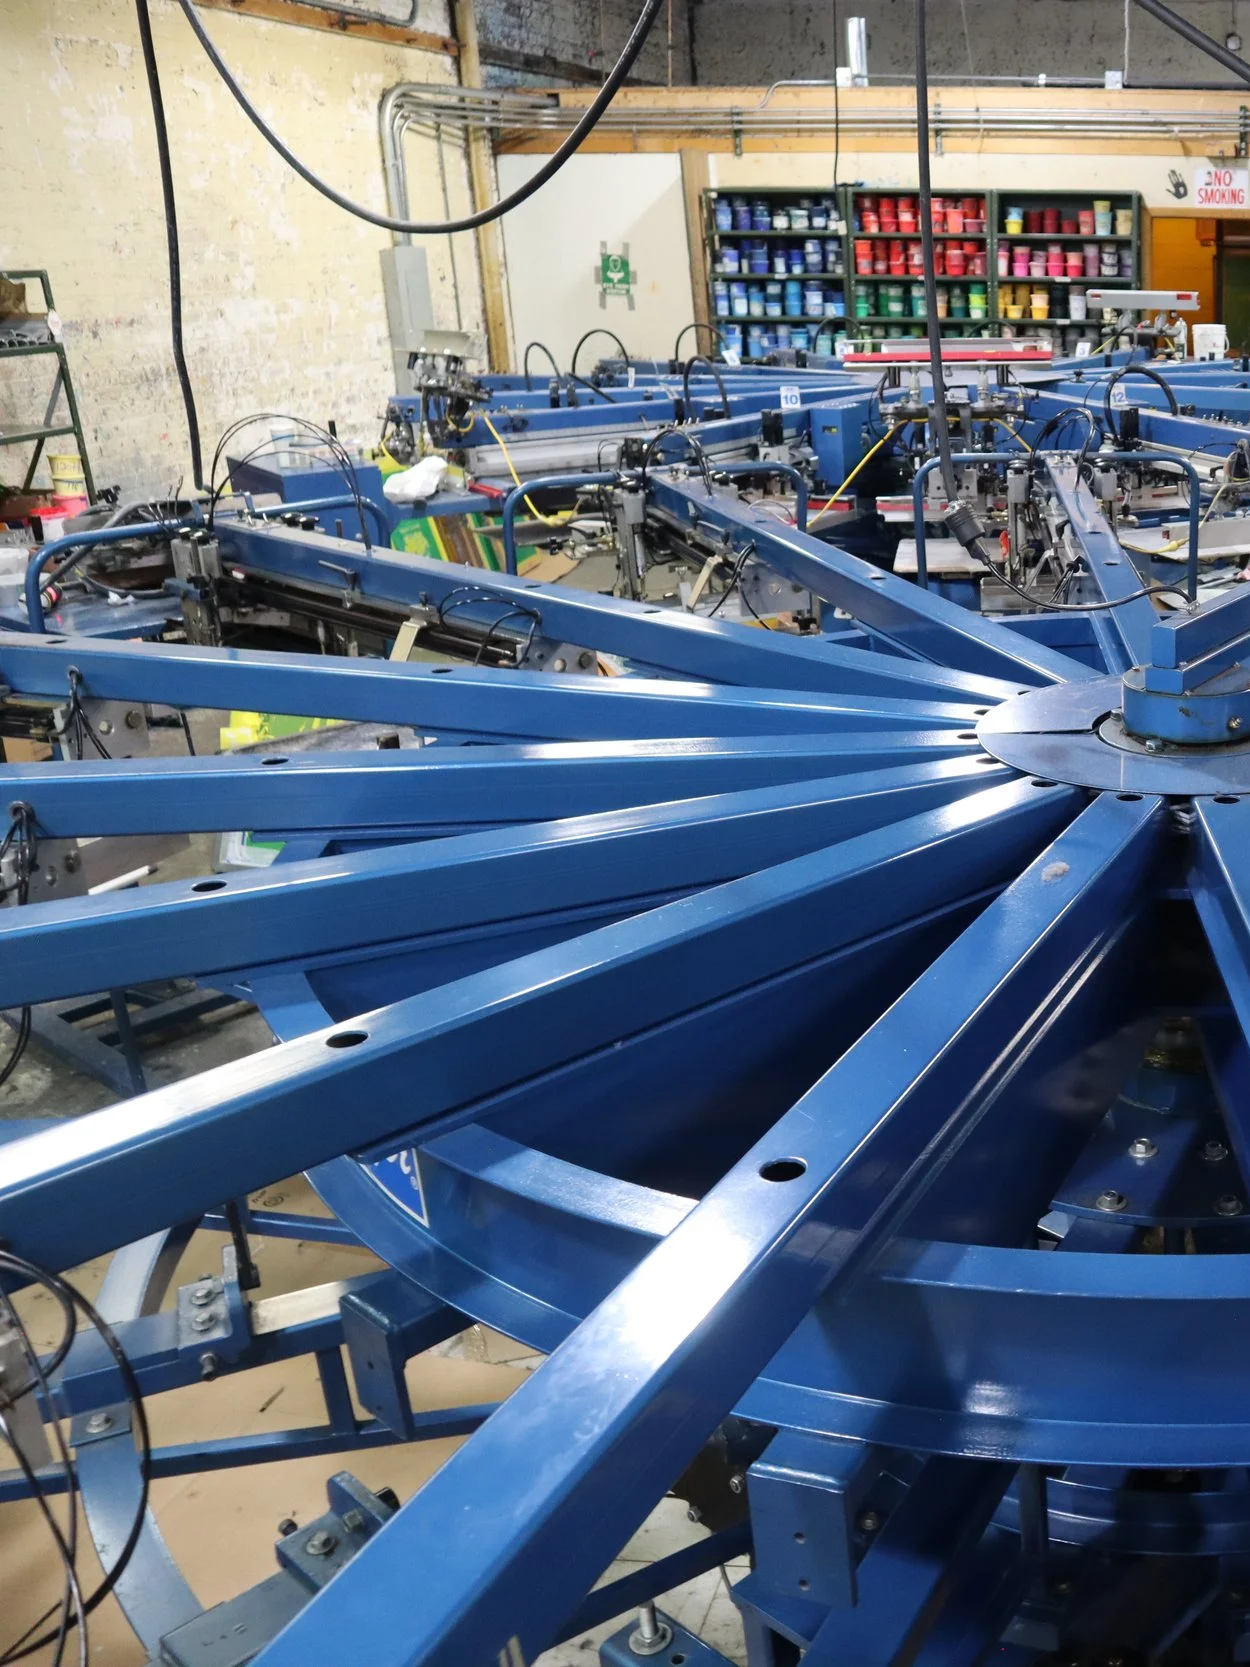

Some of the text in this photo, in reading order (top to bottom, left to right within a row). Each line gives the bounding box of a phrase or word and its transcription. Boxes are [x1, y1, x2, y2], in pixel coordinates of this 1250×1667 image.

[1213, 170, 1232, 187] NO
[1198, 188, 1245, 205] SMOKING
[783, 394, 799, 405] 10
[1112, 391, 1125, 403] 12
